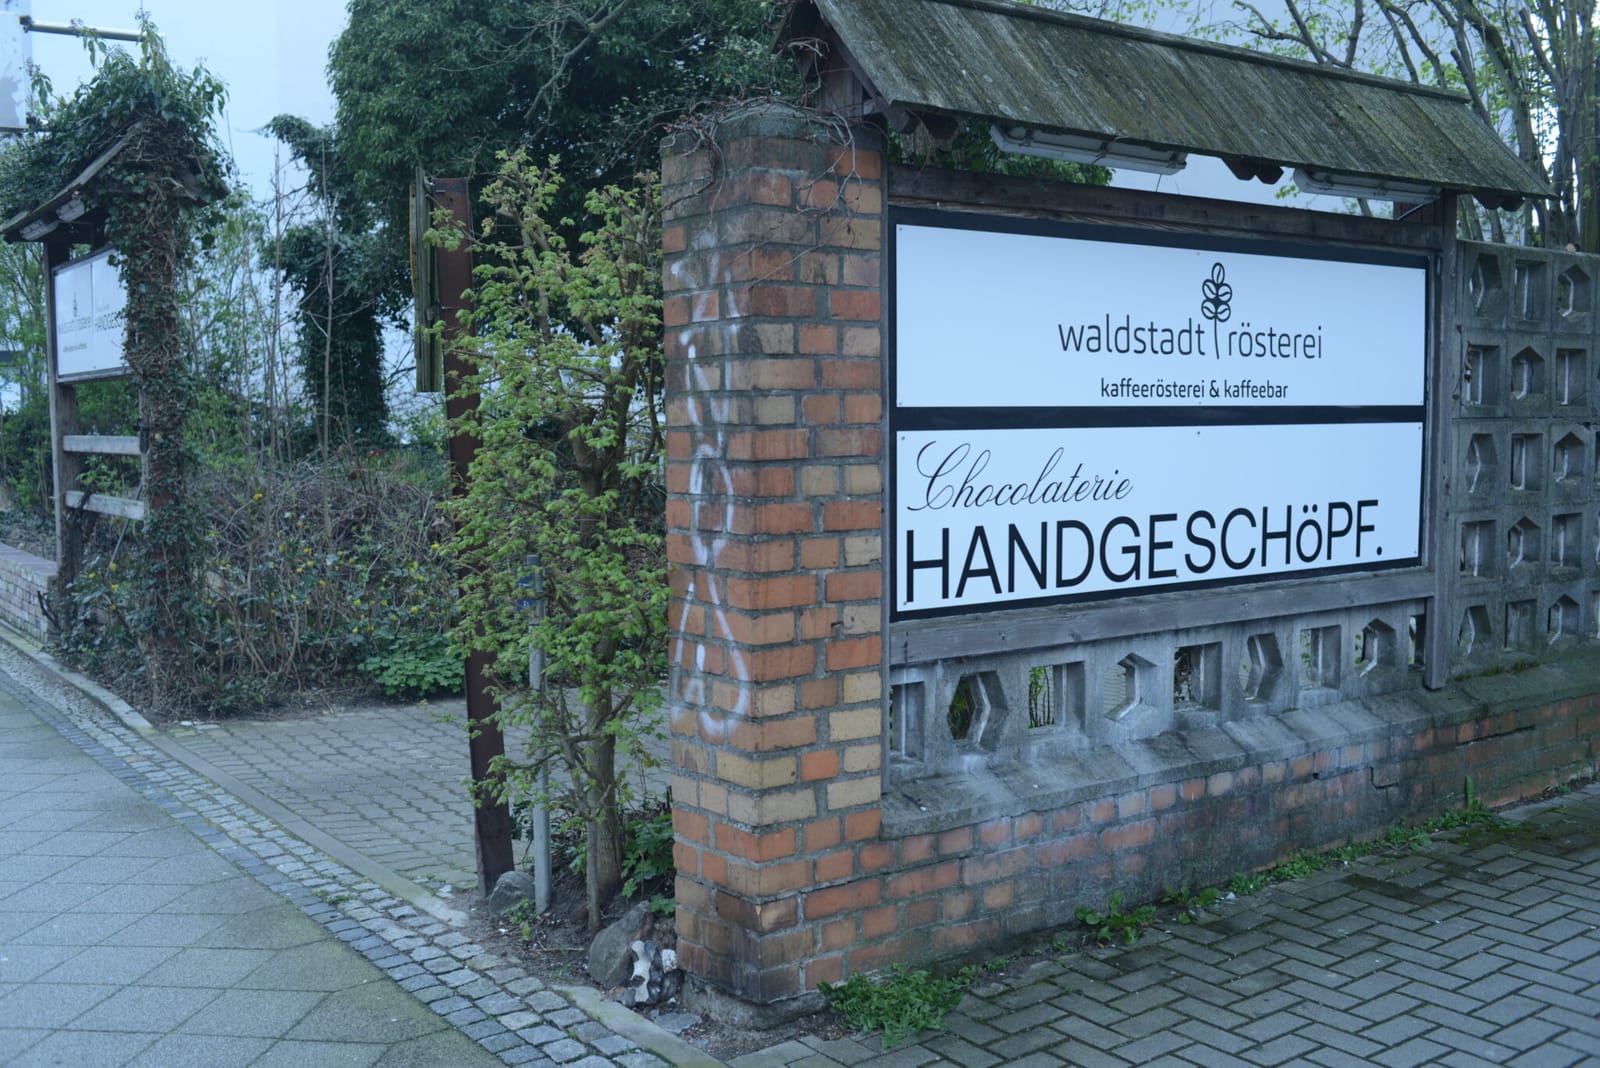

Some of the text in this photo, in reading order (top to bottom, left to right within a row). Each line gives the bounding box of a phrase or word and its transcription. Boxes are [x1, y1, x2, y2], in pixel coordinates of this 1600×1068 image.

[1058, 313, 1322, 359] waldstadt rösterei
[1101, 377, 1289, 399] kaffeerösterei & kaffeebar
[907, 440, 1134, 511] Chocolaterie
